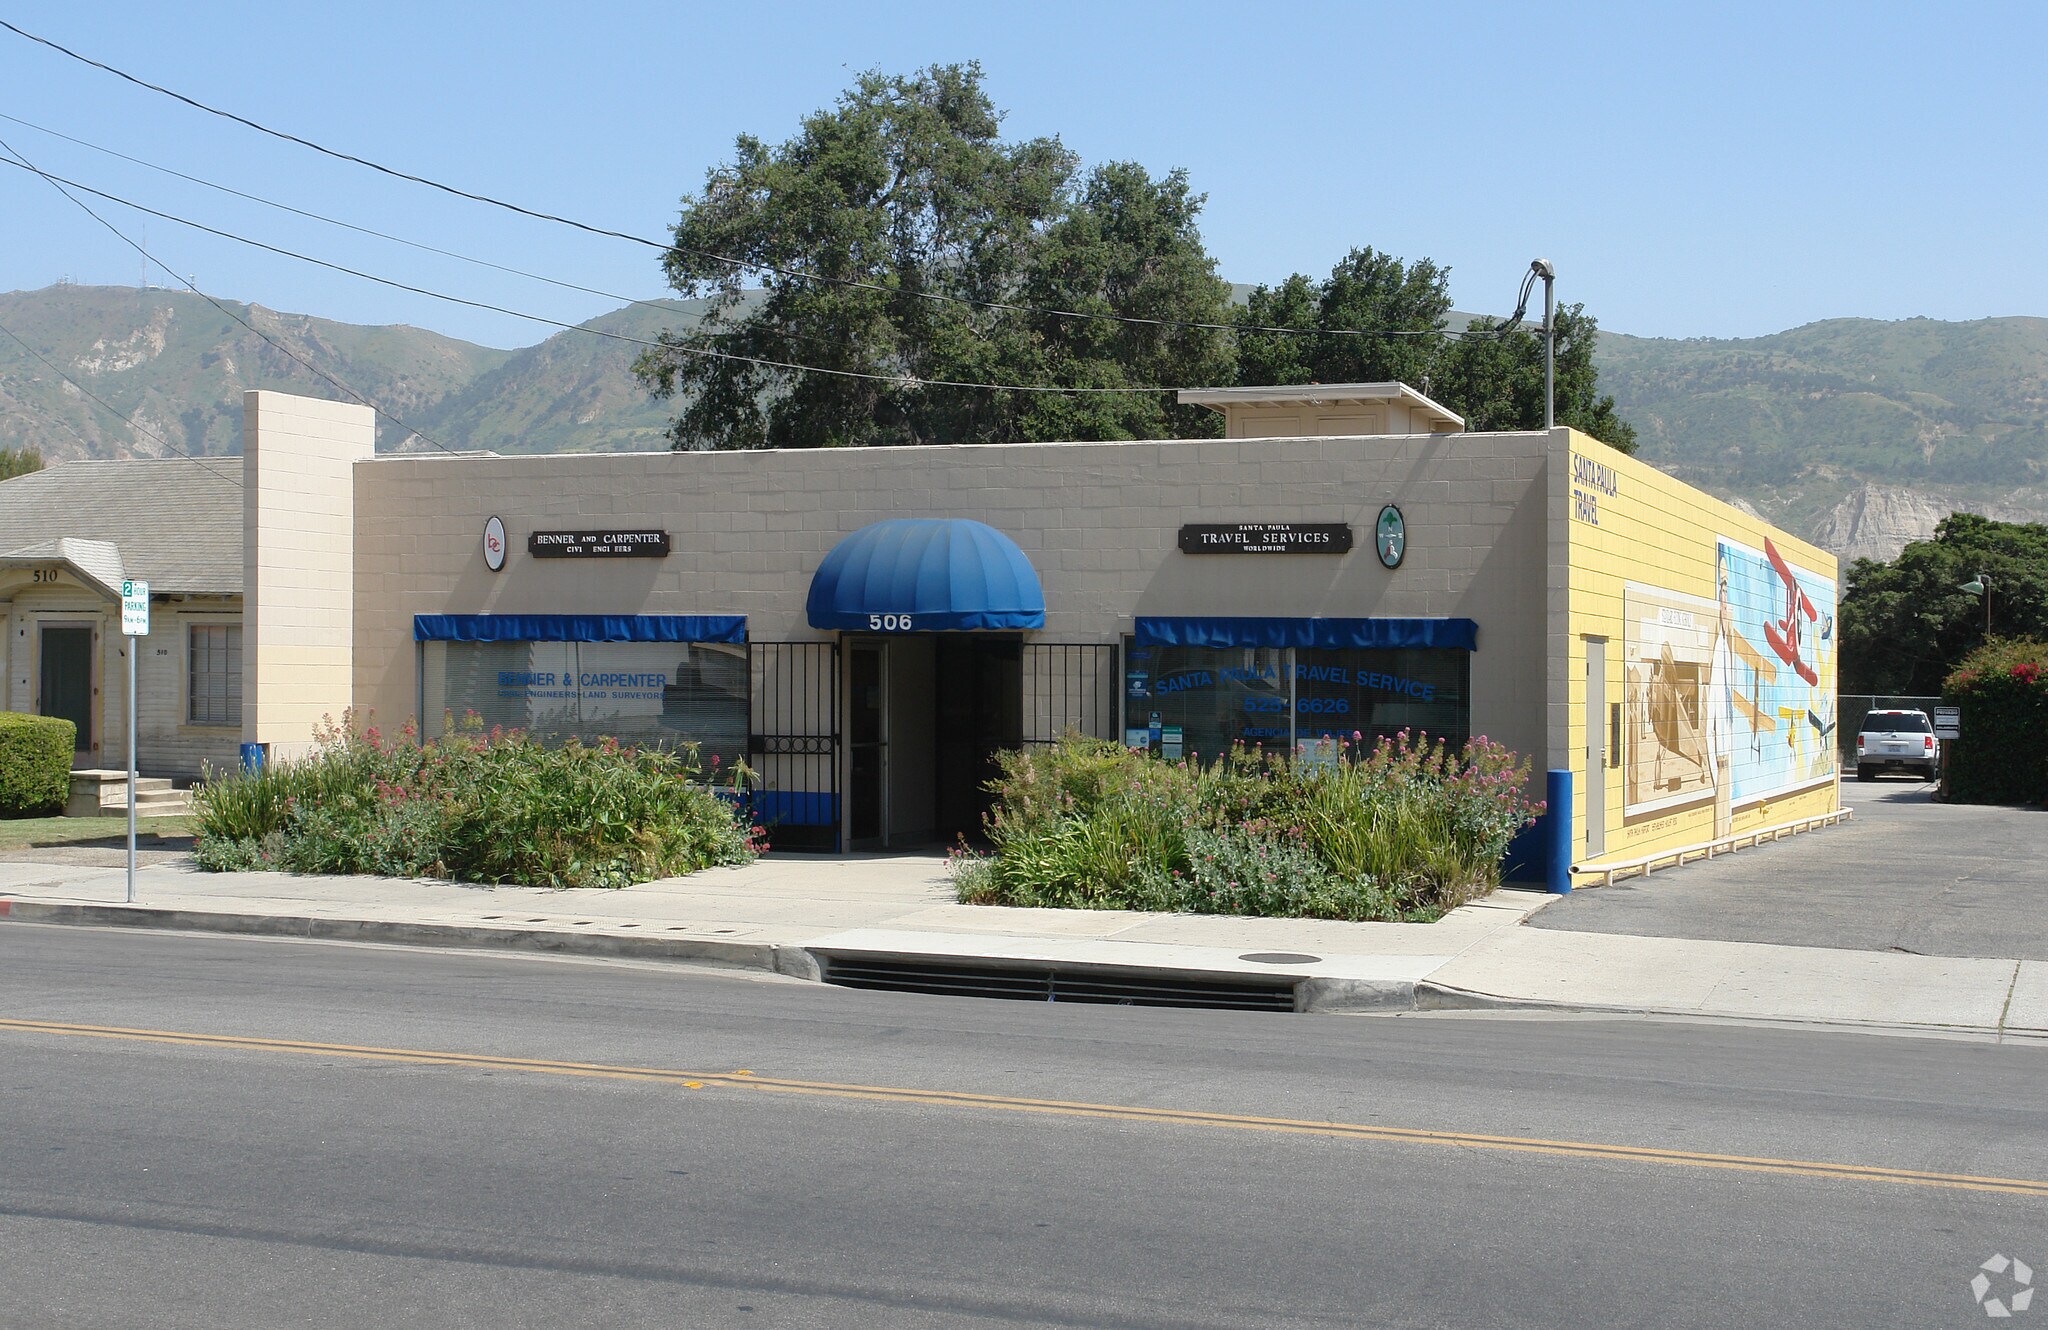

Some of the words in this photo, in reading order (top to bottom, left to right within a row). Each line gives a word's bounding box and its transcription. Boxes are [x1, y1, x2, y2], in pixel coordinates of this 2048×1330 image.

[1574, 453, 1596, 490] SANTA
[1597, 464, 1617, 498] PAULA
[1574, 489, 1598, 525] TRAVEL
[537, 535, 575, 545] BENNER
[603, 533, 660, 545] CARPENTER
[1201, 533, 1249, 544] TRAVEL
[1262, 532, 1329, 543] SERVICES
[33, 570, 58, 583] 510
[125, 583, 132, 596] 2
[134, 587, 146, 596] HOUR
[125, 601, 147, 612] PARKING
[869, 614, 912, 631] 506
[498, 672, 555, 687] BENNER
[562, 673, 572, 687] &
[580, 673, 666, 688] CARPENTER
[1156, 671, 1213, 696] SANTA
[1219, 665, 1276, 688] PAULA
[1284, 664, 1350, 685] TRAVEL
[1356, 671, 1437, 703] SERVICE
[582, 691, 607, 699] LAND
[612, 692, 664, 700] SURVEYORS
[1244, 727, 1290, 738] AGENCIA
[1296, 728, 1310, 738] DE
[1316, 728, 1354, 739] VIAJES
